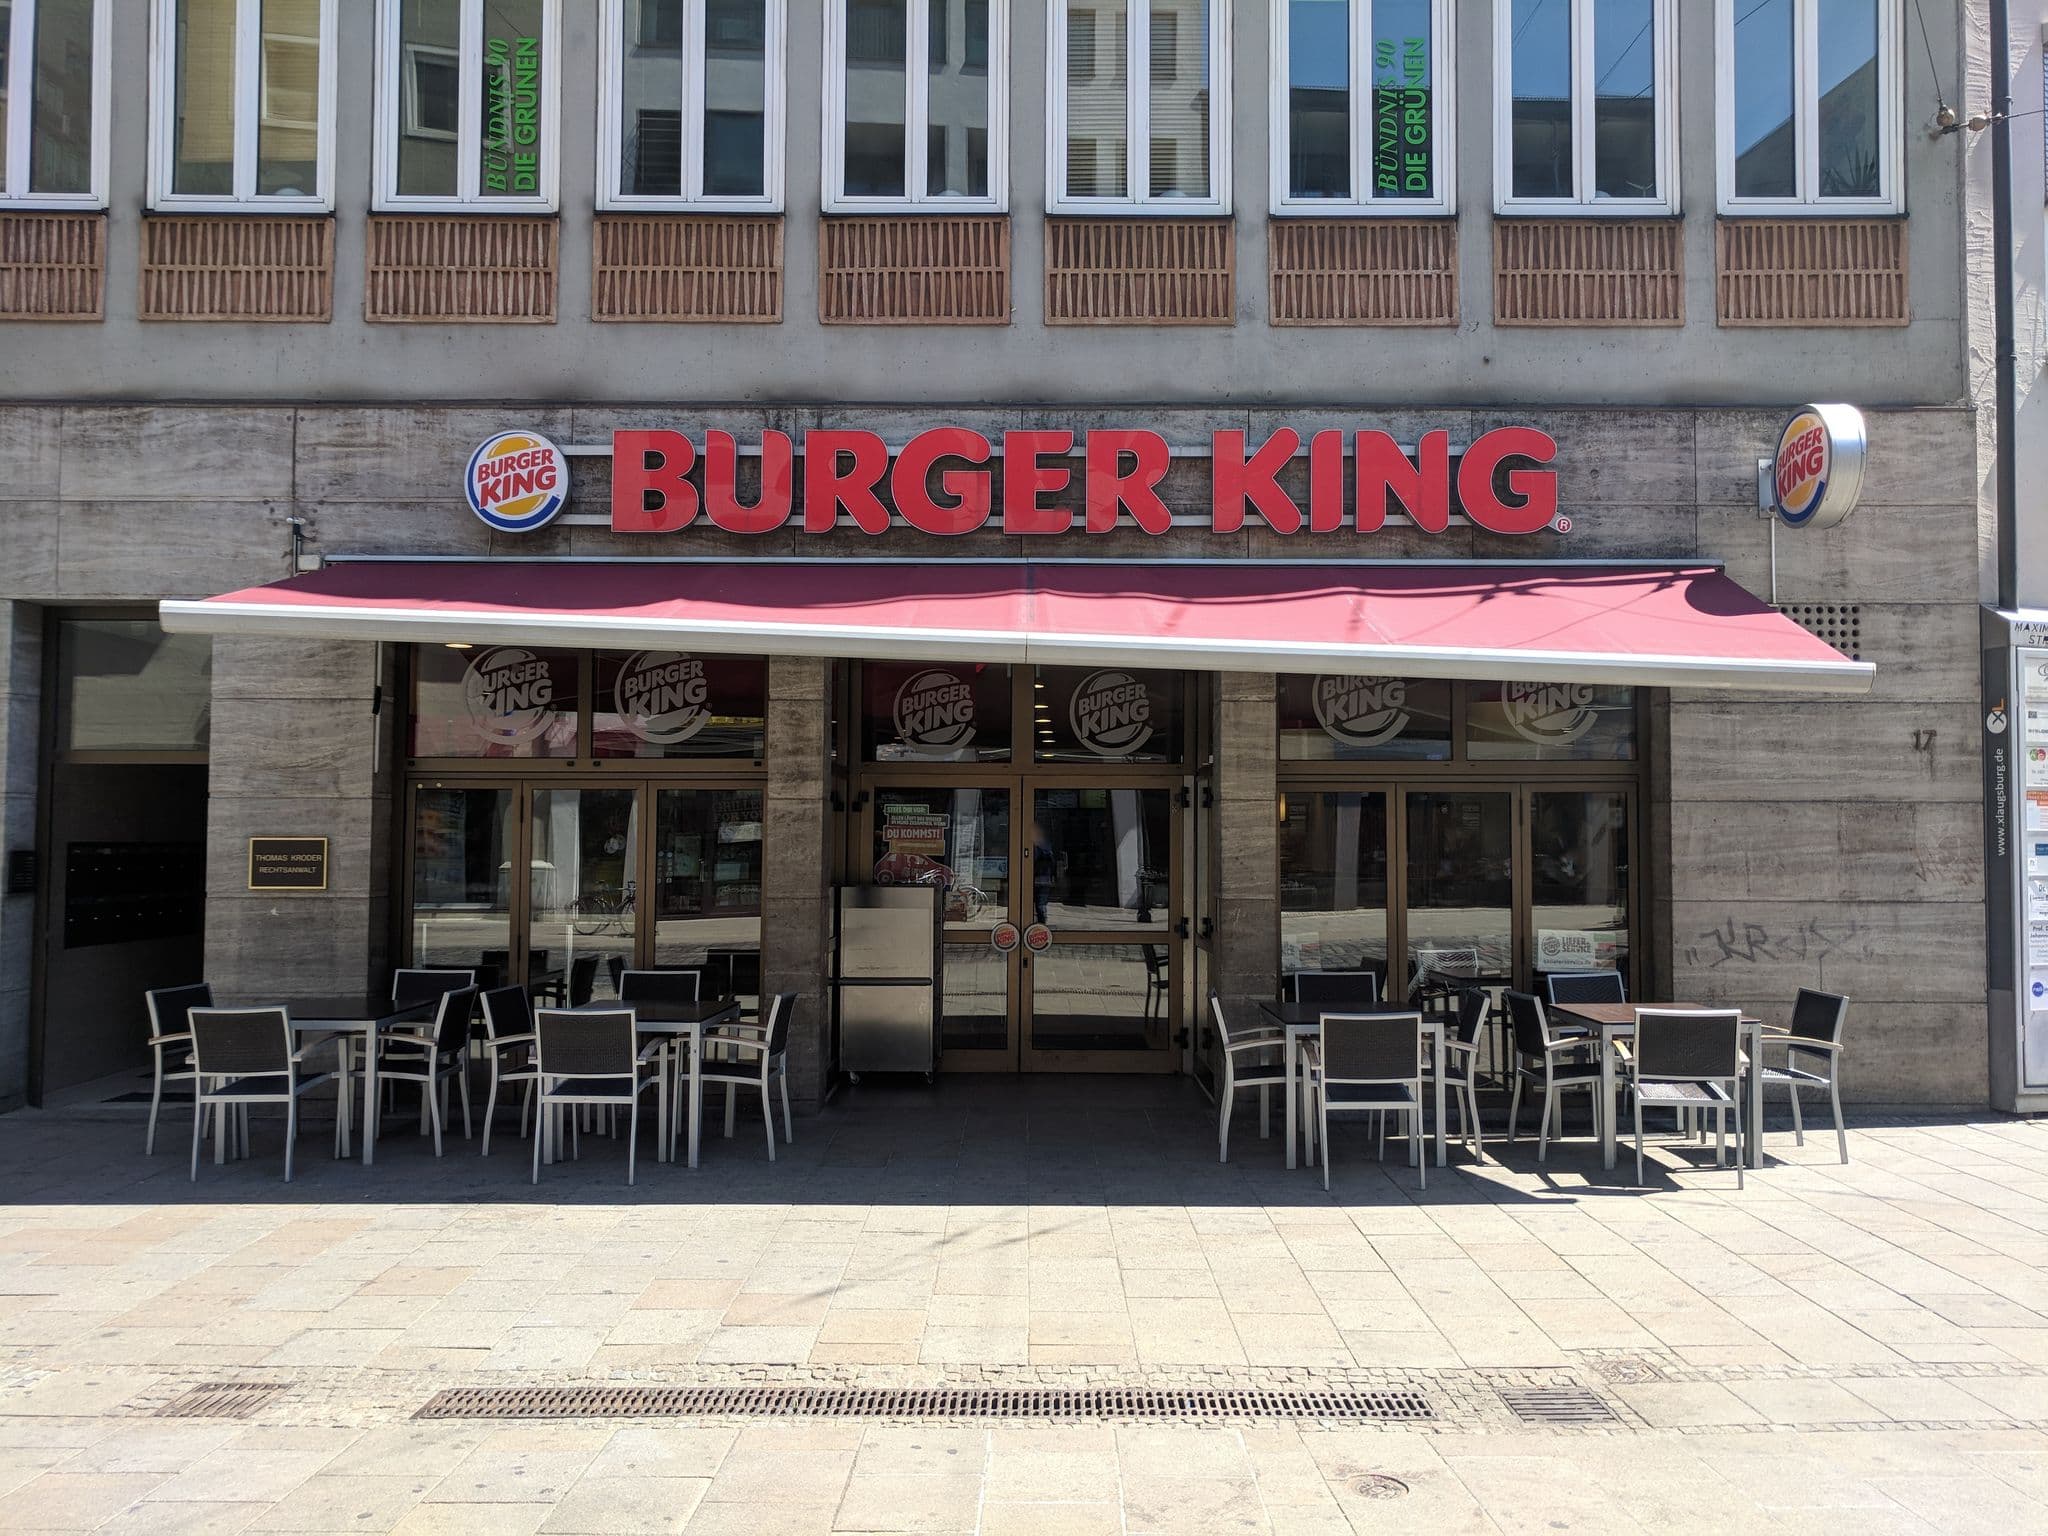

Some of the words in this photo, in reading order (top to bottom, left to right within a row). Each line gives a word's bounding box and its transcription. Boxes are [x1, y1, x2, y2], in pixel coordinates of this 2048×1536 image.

[1376, 39, 1396, 68] 90
[511, 37, 537, 145] GRÜNEN
[1400, 37, 1427, 145] GRÜNEN
[485, 74, 508, 192] BÜNDNIS
[1375, 75, 1398, 192] BÜNDNIS
[514, 152, 536, 191] DIE
[1405, 153, 1427, 191] DIE
[478, 449, 553, 483] BURGER
[611, 427, 1173, 535] BURGER
[1212, 426, 1558, 535] KING
[1778, 446, 1823, 504] KING
[480, 465, 556, 508] KING
[477, 661, 549, 693] URGER
[624, 660, 704, 699] BURGER
[1323, 675, 1400, 700] BUR
[628, 678, 707, 720] KING
[902, 685, 971, 716] BURGER
[904, 699, 974, 737] KING
[1078, 683, 1146, 717] BURGER
[1081, 699, 1150, 738] KING
[1326, 681, 1405, 726] KING
[1515, 684, 1593, 725] KING
[1913, 730, 1937, 750] 17
[1994, 748, 2006, 857] www.xlaugsburg.de
[887, 829, 899, 839] DU
[901, 829, 940, 839] KOMMST!
[255, 854, 289, 862] THOMAS
[258, 866, 318, 874] RECHTSANWALT
